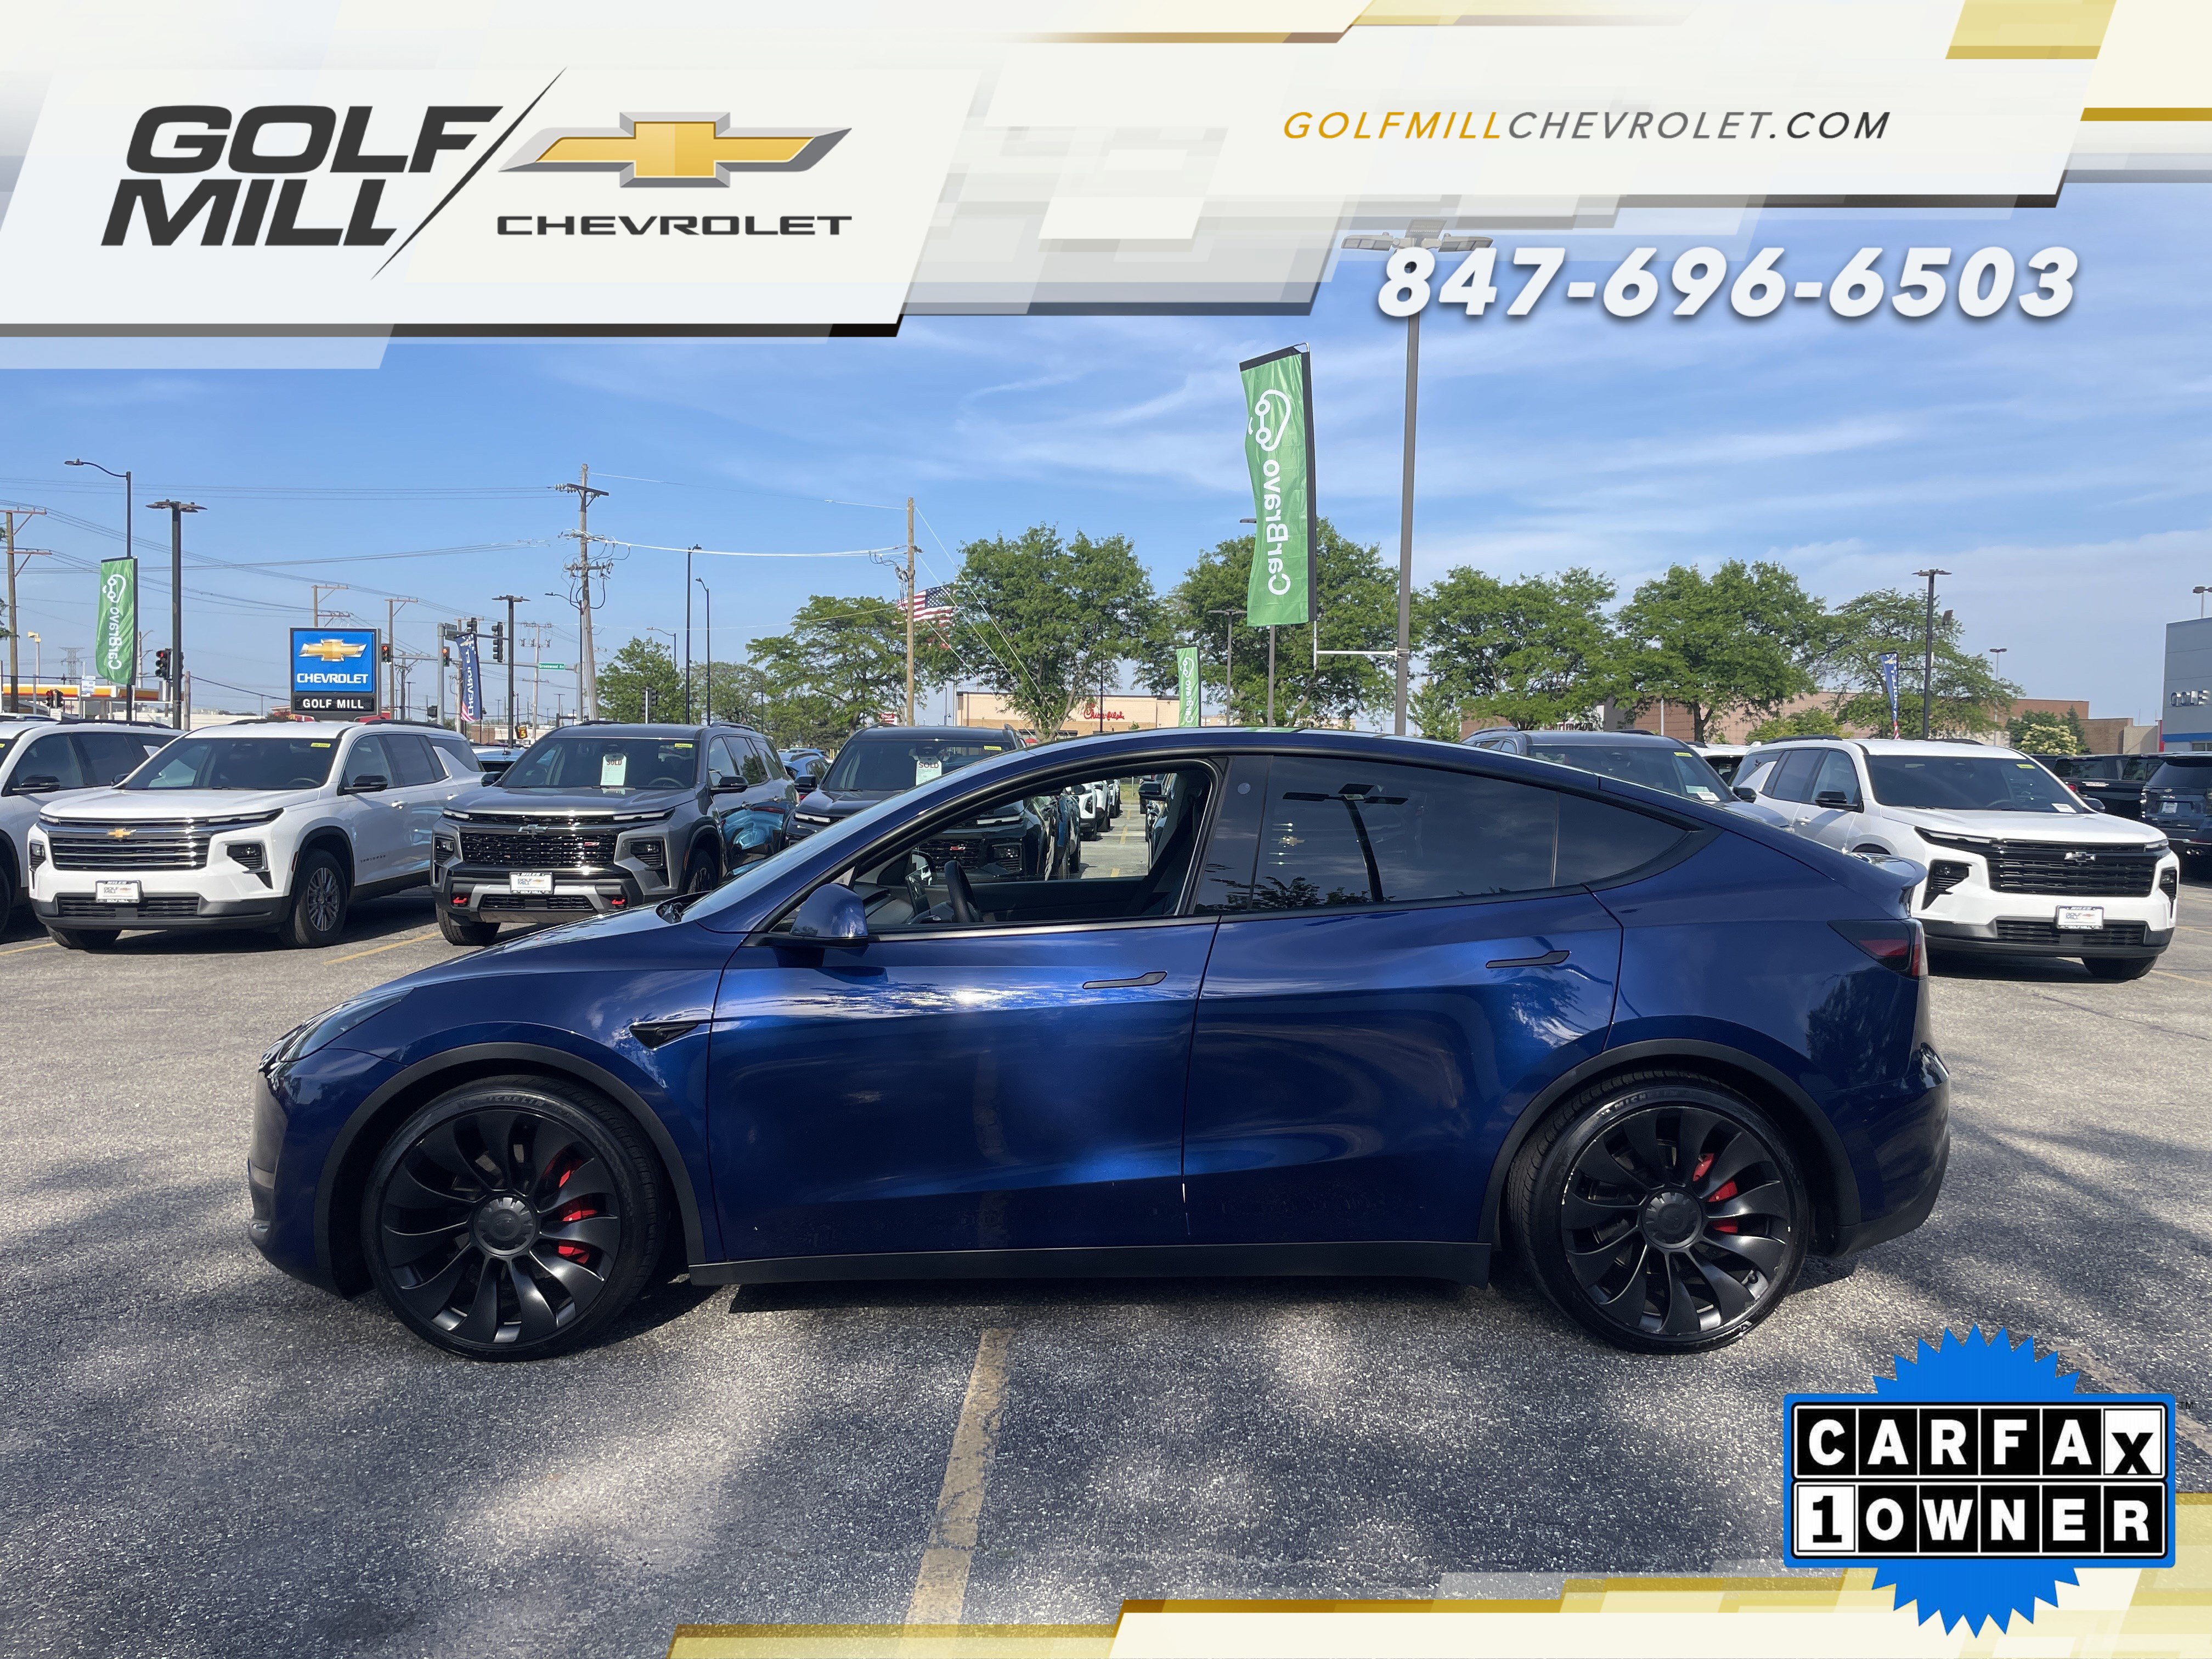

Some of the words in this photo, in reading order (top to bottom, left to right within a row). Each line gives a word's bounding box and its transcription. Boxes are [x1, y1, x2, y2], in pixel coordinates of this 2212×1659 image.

[297, 673, 369, 684] CHEVROLET
[303, 699, 332, 709] GOLF
[337, 699, 364, 709] MILL
